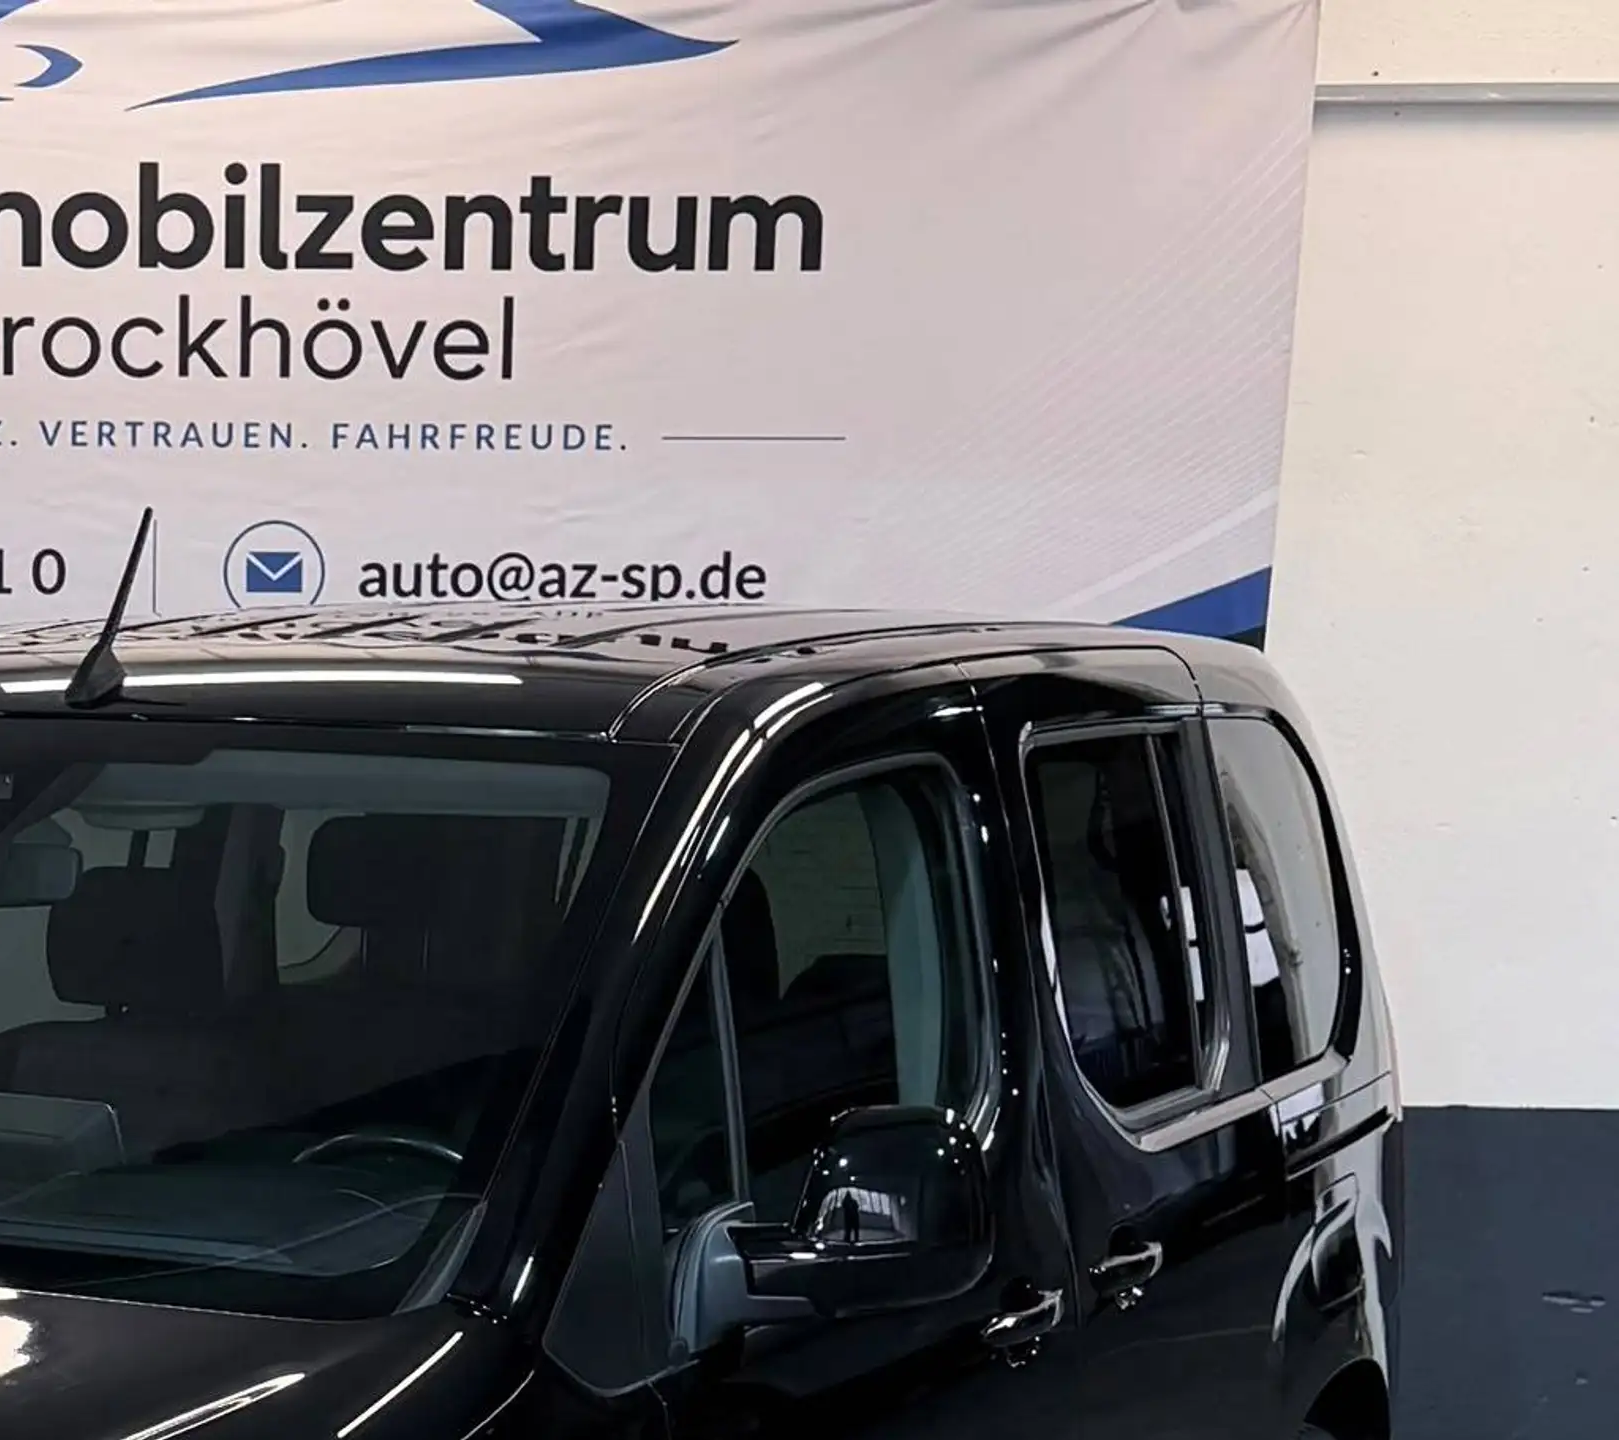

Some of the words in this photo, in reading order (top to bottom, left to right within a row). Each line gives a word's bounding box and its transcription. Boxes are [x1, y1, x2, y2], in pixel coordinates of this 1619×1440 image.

[38, 420, 308, 449] VERTRAUEN.
[332, 422, 627, 452] FAHRFREUDE.
[32, 548, 66, 595] 0
[358, 550, 767, 601] auto@az-sp.de
